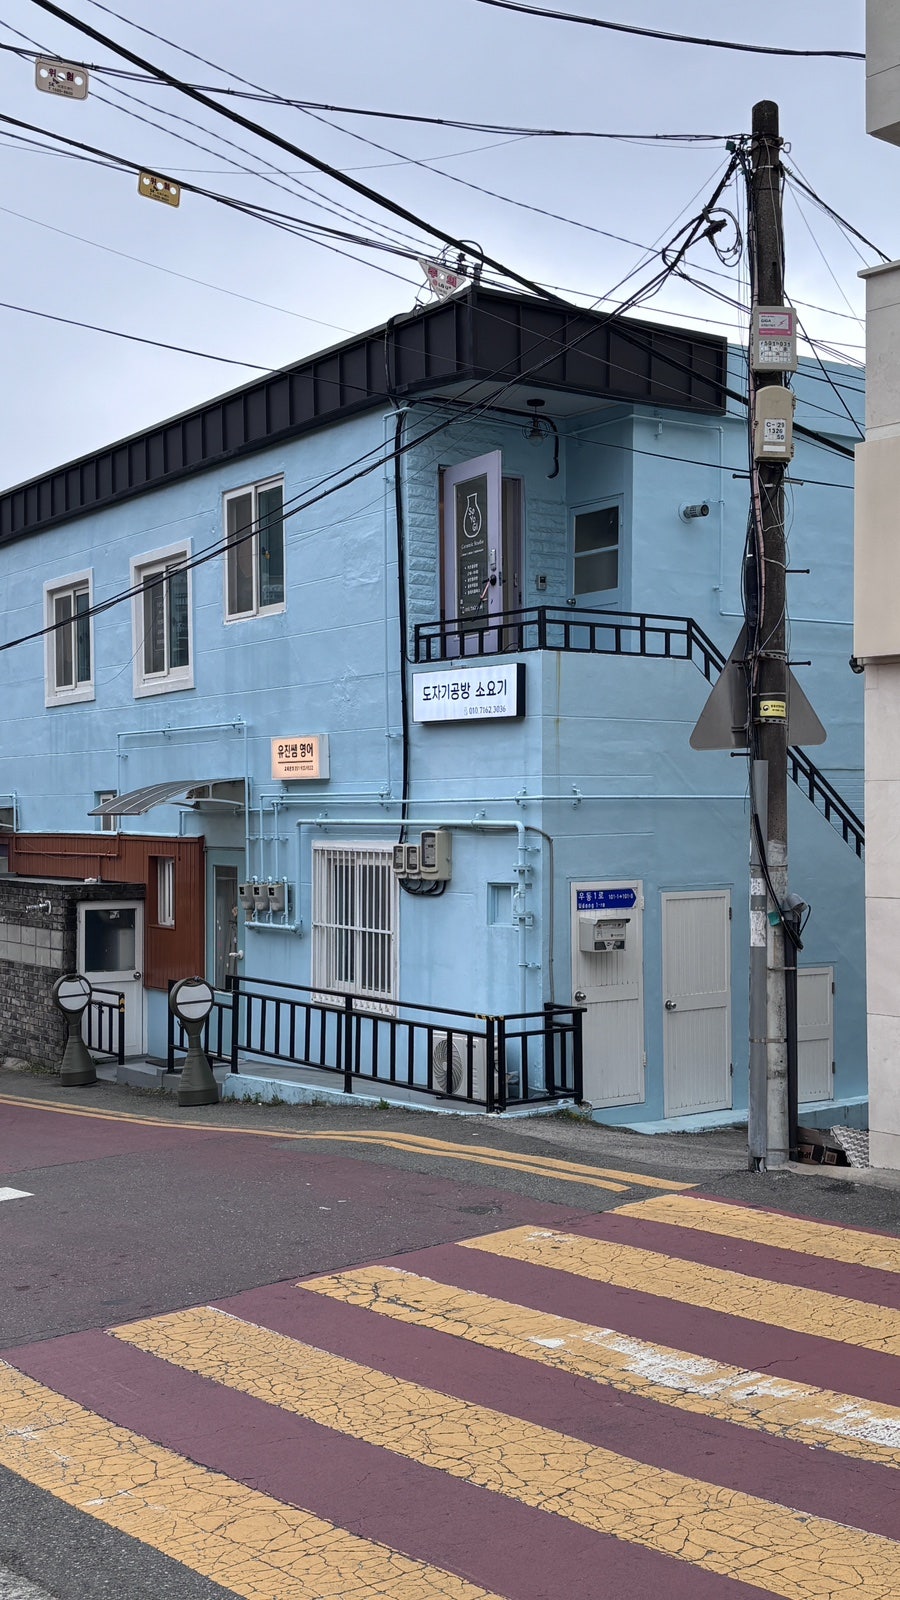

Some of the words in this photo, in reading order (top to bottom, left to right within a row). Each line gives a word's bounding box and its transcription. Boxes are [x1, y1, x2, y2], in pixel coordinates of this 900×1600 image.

[422, 682, 471, 701] 도자기공방
[475, 679, 507, 697] 소요기
[277, 744, 298, 759] 유진쌤
[299, 742, 314, 758] 영어
